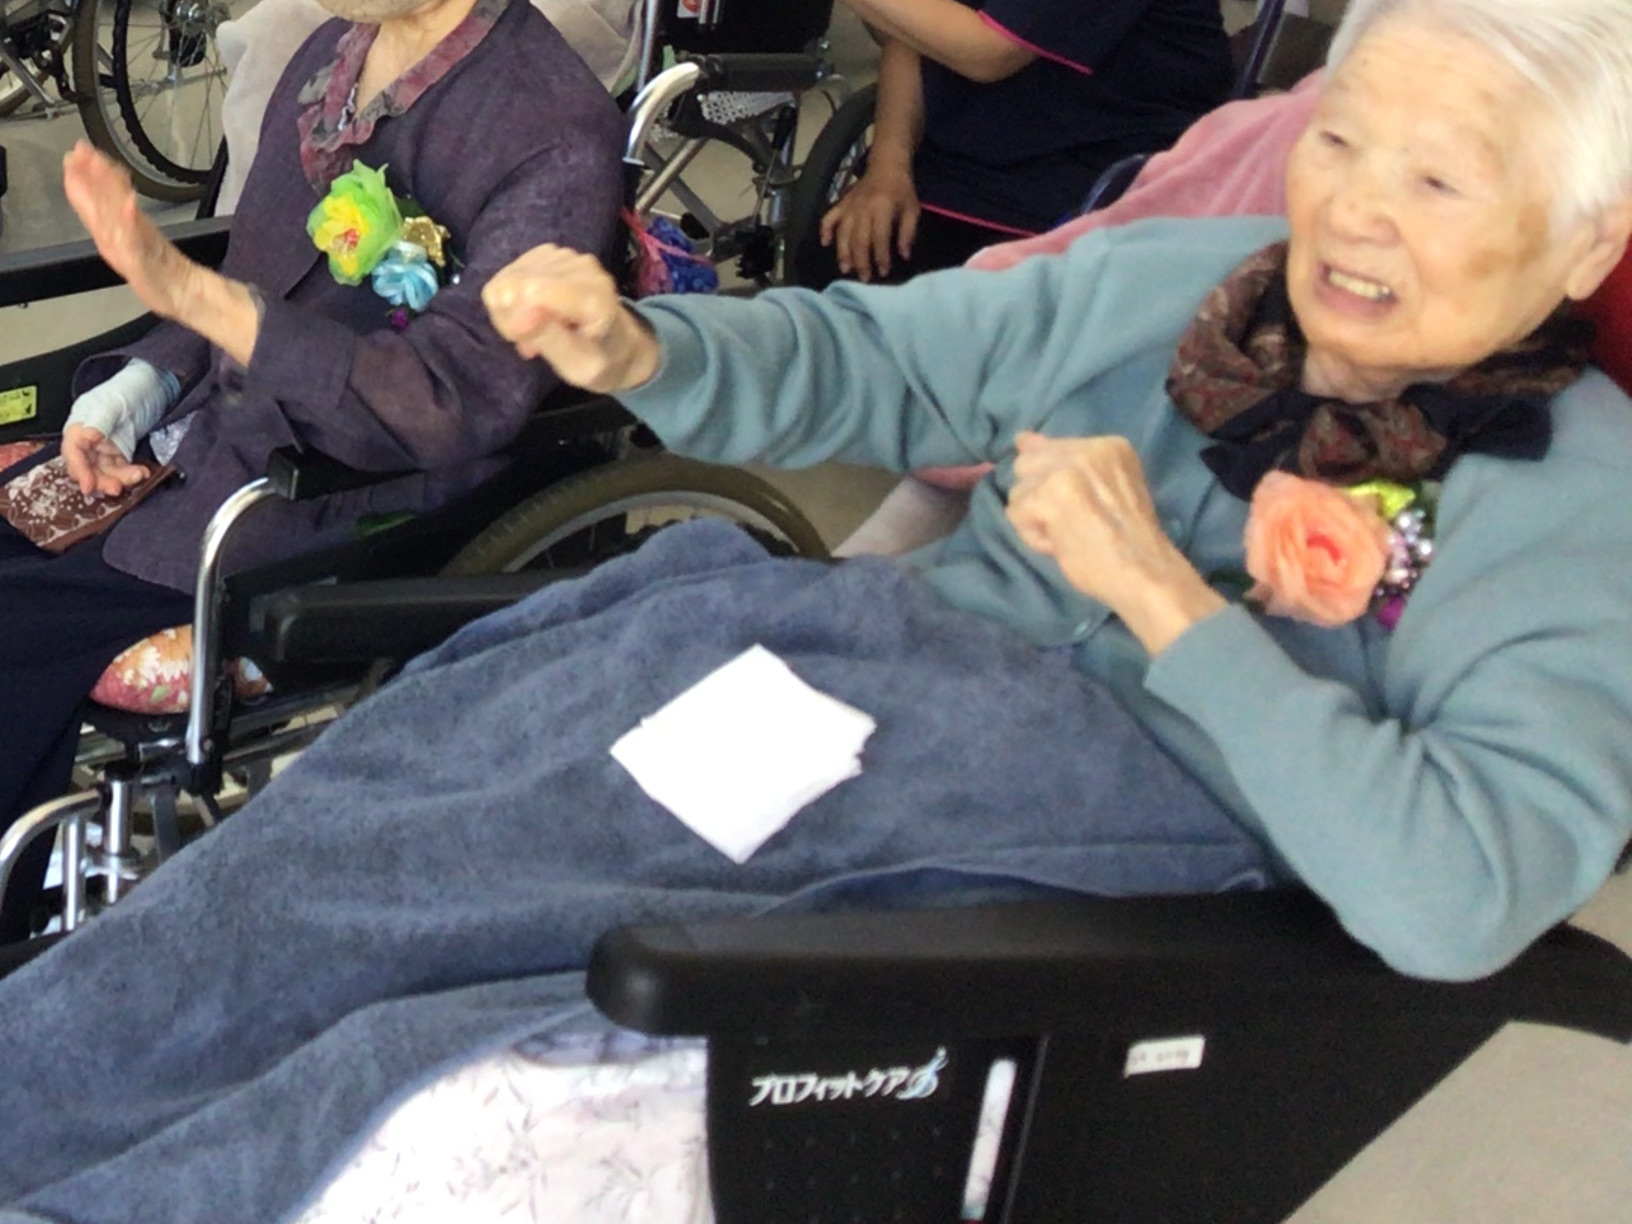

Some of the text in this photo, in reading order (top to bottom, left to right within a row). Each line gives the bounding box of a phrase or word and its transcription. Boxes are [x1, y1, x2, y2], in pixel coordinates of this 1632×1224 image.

[748, 1066, 911, 1107] プロフィットケア
